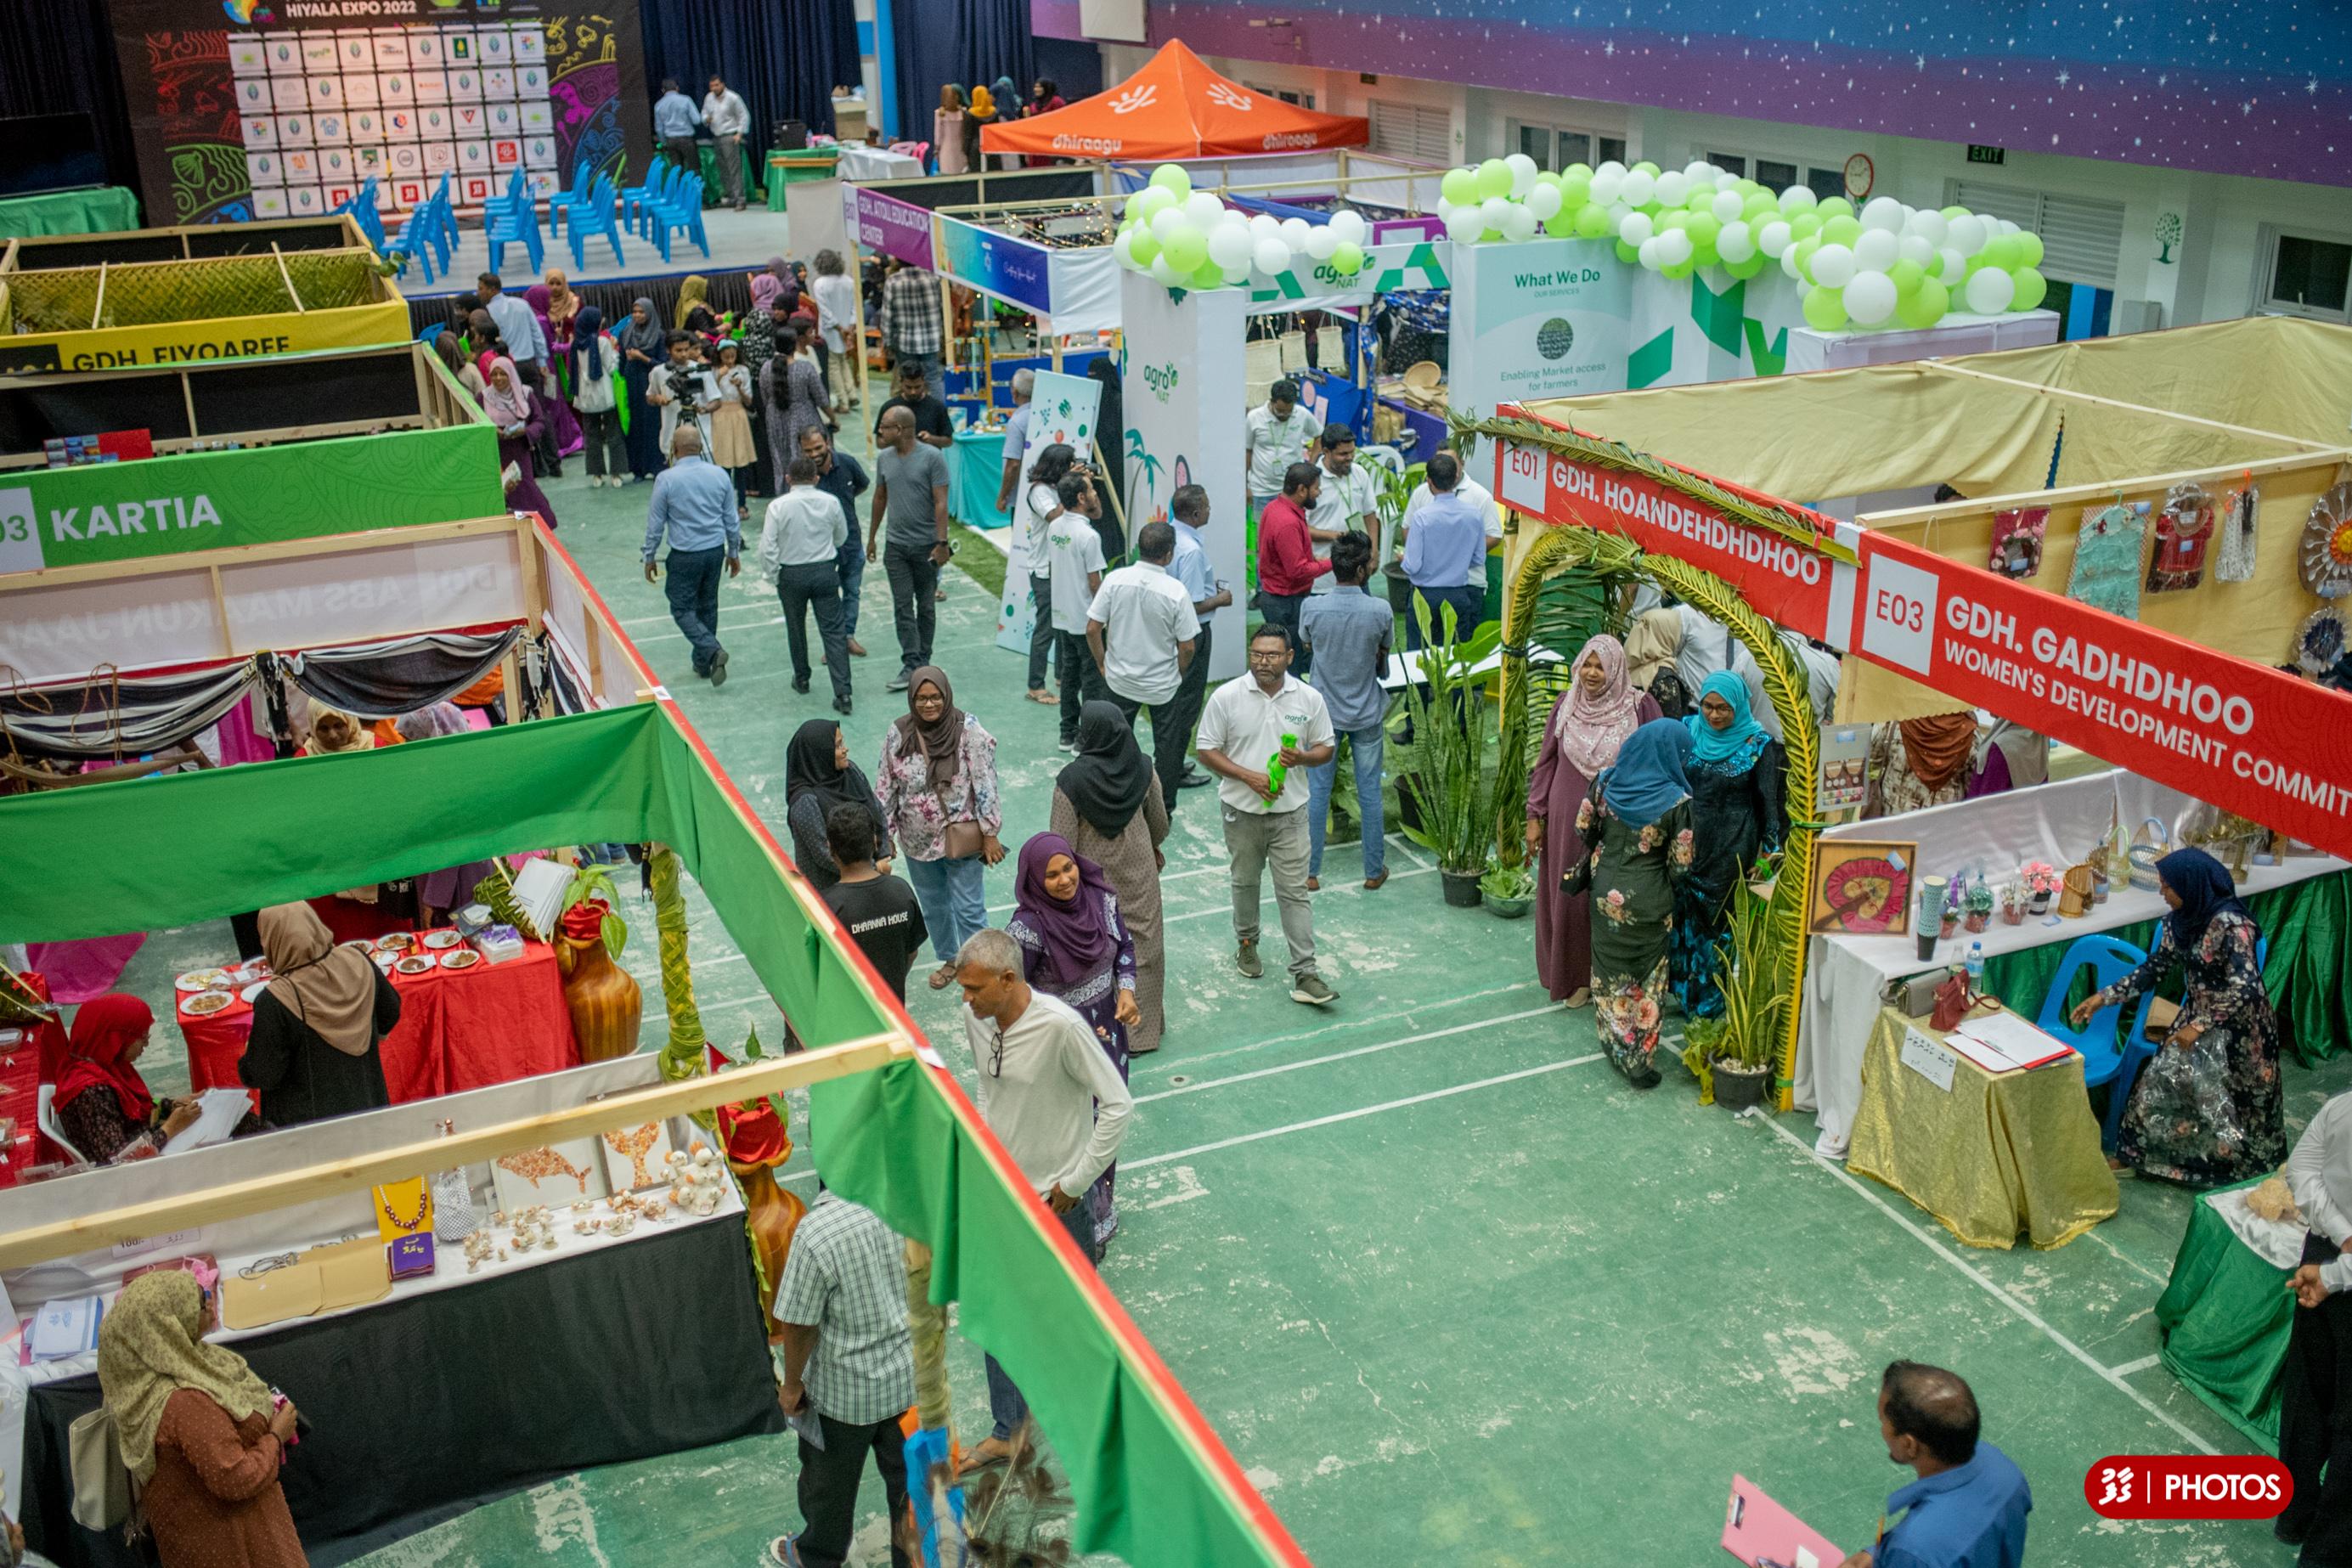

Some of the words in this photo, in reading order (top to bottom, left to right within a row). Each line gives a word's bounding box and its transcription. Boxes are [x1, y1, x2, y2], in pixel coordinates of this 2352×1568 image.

[285, 2, 341, 18] HIYALA
[341, 1, 381, 16] EXPO
[384, 1, 417, 15] 2022
[1052, 133, 1122, 155] dhiraagu
[1972, 145, 2001, 162] EXIT
[874, 200, 892, 222] ATOLL
[892, 205, 929, 233] EDUCATION
[861, 223, 884, 246] CENTER
[1514, 273, 1553, 288] What
[1556, 270, 1578, 285] We
[1582, 268, 1601, 282] Do
[1534, 290, 1548, 298] OUR
[1549, 287, 1580, 296] SERVICES
[1500, 369, 1541, 381] Enabling
[1542, 366, 1574, 377] Market
[1575, 362, 1606, 374] access
[1528, 381, 1542, 392] for
[1543, 379, 1579, 390] farmers
[1511, 448, 1538, 481] E01
[50, 494, 223, 542] KARTIA
[1552, 461, 1600, 503] GDH.
[1604, 479, 1821, 586] HOANDEHDHDHOO
[1875, 588, 1926, 635] E03
[1946, 596, 2024, 653] GDH.
[2032, 627, 2254, 736] GADHDHOO
[1944, 637, 2046, 698] WOMEN'S
[2050, 680, 2228, 768] DEVELOPMENT
[2232, 751, 2352, 817] COMMIT
[887, 911, 909, 926] HOUSE
